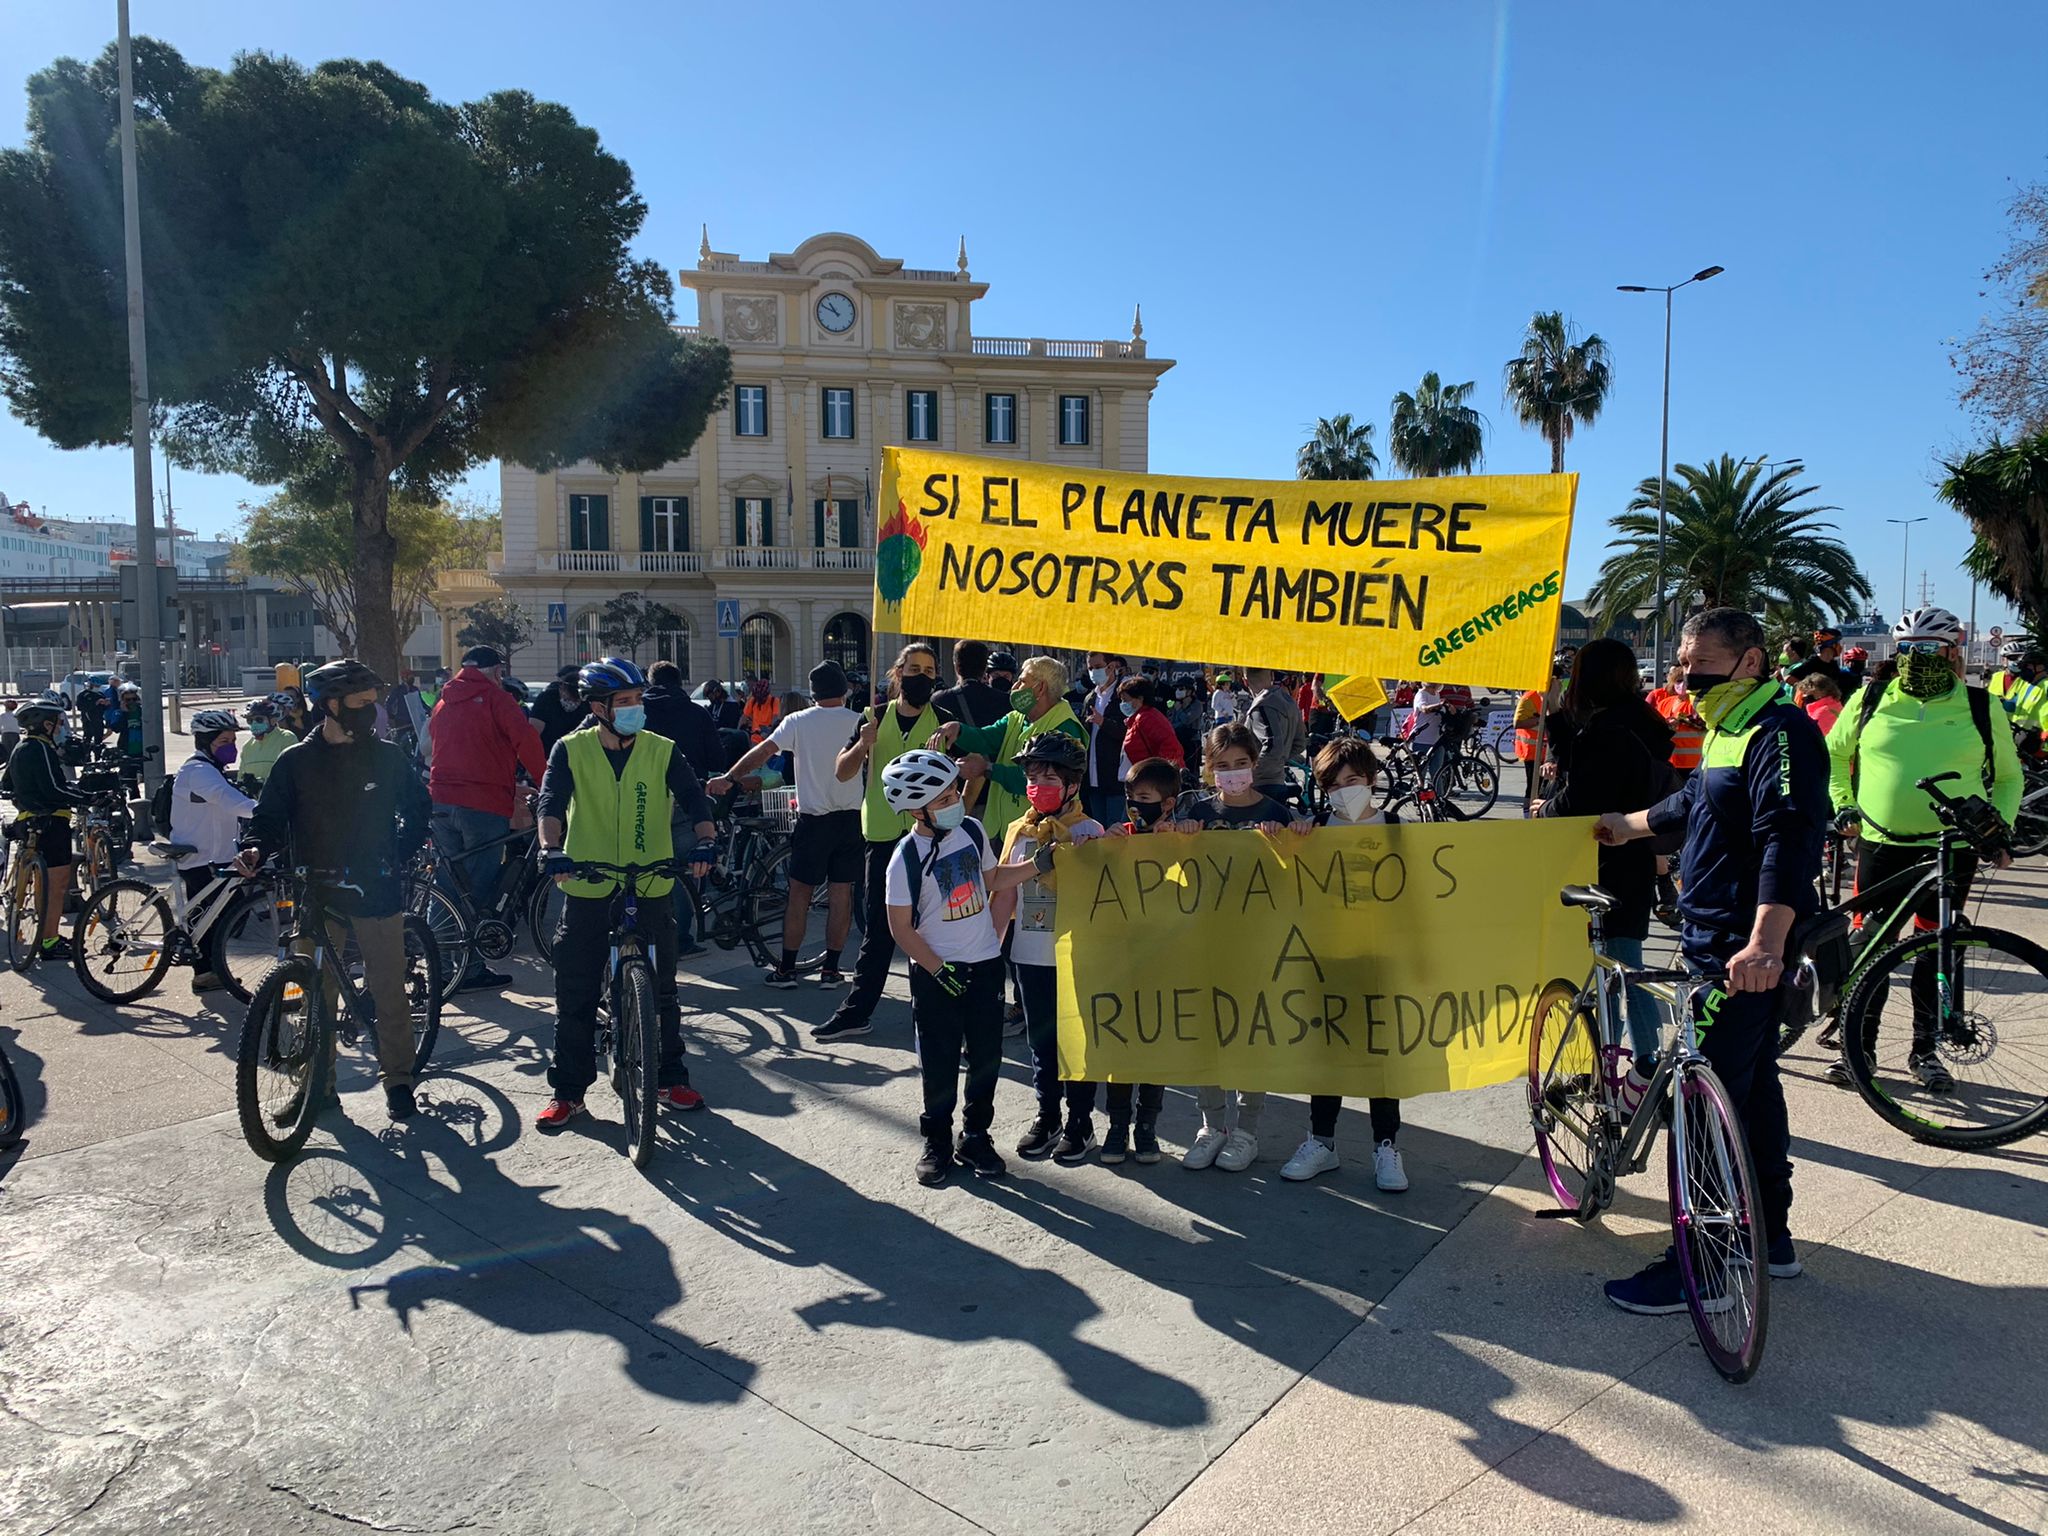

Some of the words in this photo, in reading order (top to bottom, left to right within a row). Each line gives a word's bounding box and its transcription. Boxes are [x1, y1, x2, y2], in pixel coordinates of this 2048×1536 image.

[920, 474, 959, 519] SI
[981, 477, 1038, 528] EL
[1062, 482, 1280, 544] PLANETA
[1301, 500, 1488, 554] MUERE
[938, 542, 1187, 611] NOSOTRXS
[1211, 556, 1429, 631] TAMBIÉN
[1418, 570, 1561, 668] GREENPEACE
[1777, 730, 1791, 797] GIVOVA
[634, 781, 648, 854] GREENPEACE
[1089, 844, 1458, 923] APOYAMOS
[1272, 923, 1326, 983] A
